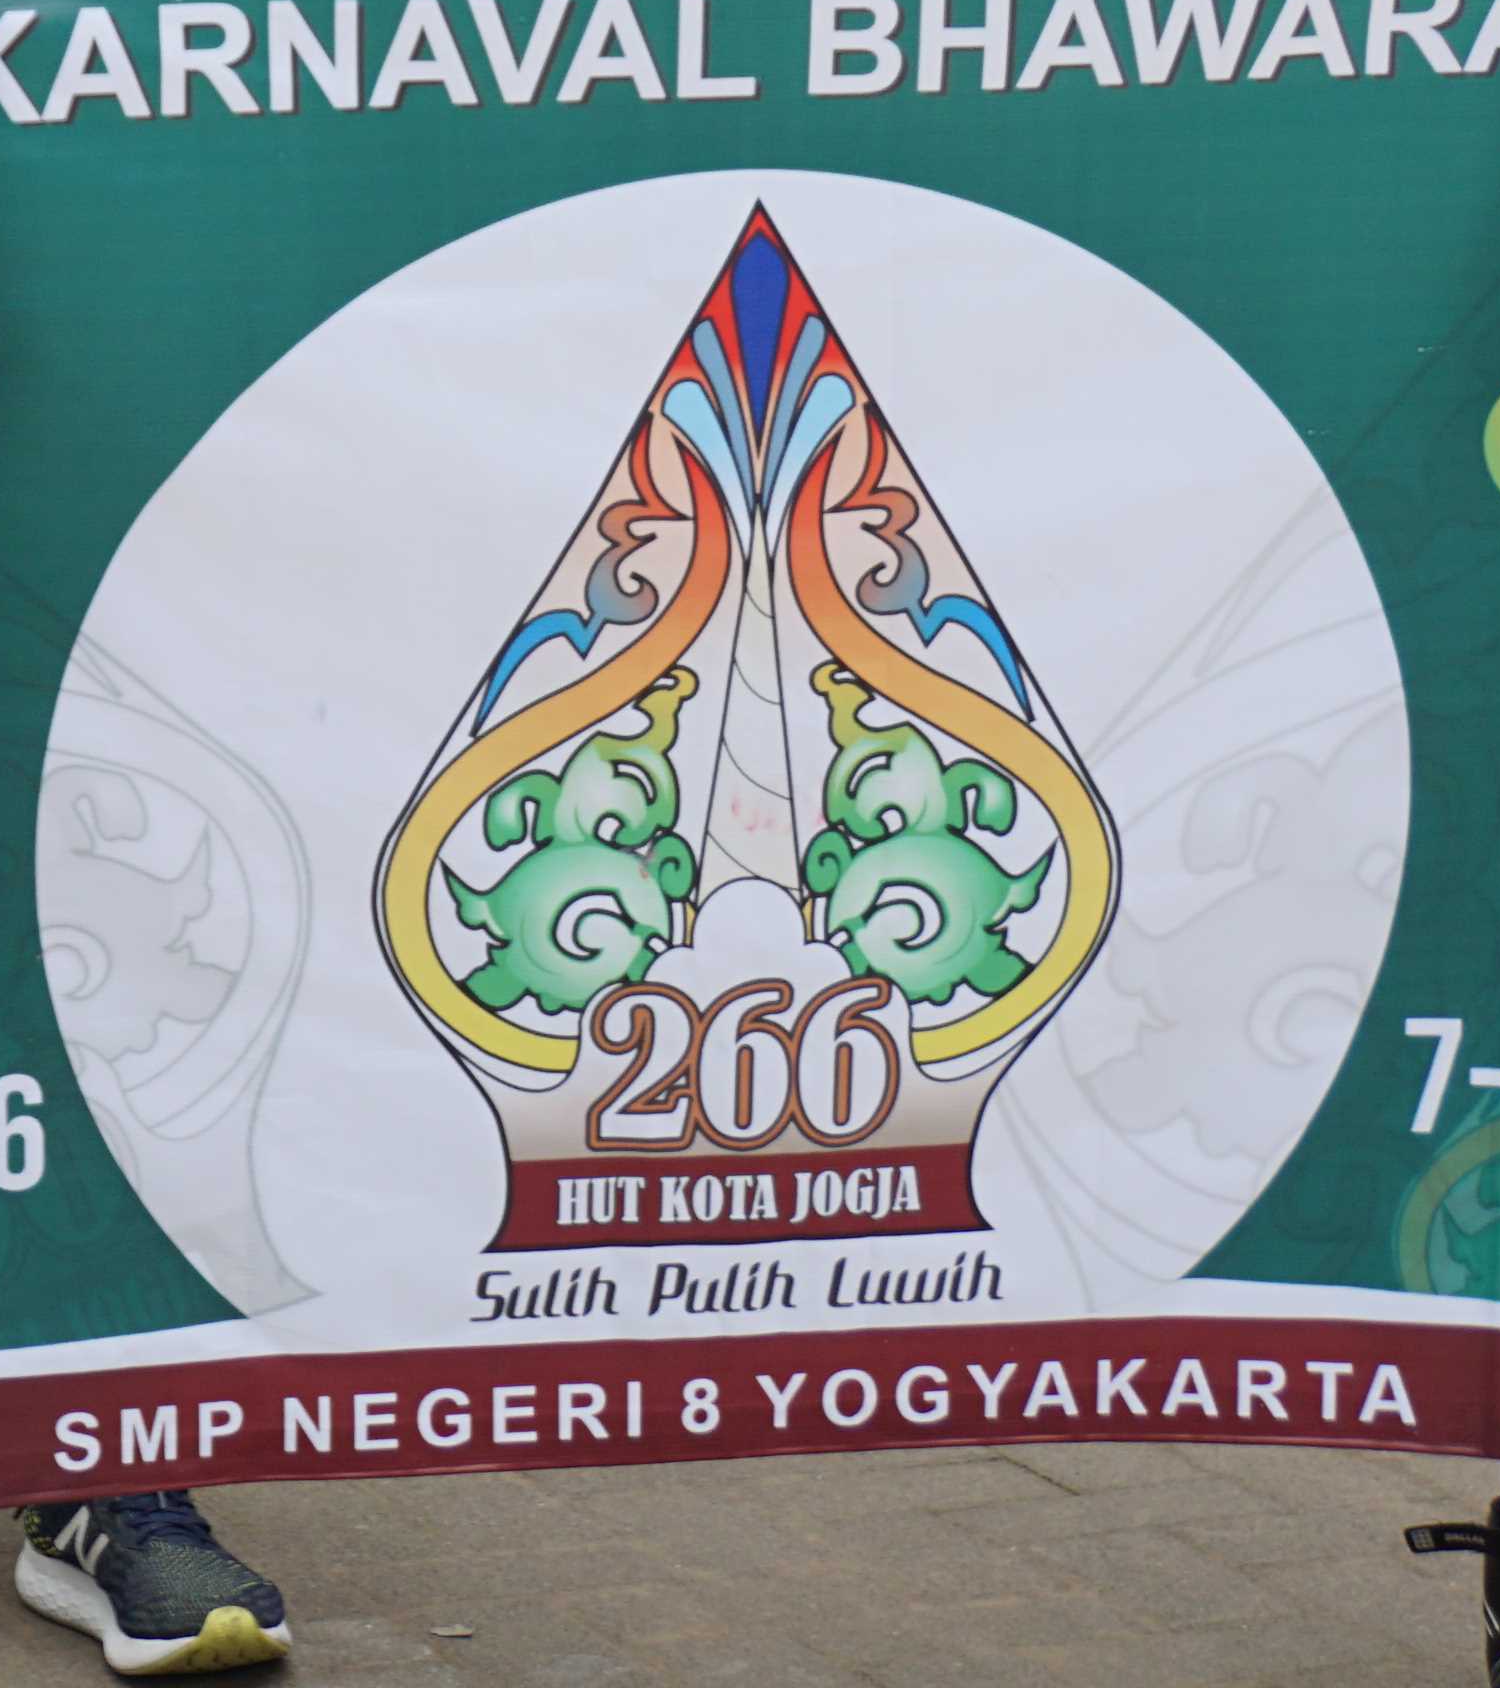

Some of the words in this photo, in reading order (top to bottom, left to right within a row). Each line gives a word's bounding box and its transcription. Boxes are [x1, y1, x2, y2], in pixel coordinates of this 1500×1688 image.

[585, 977, 900, 1152] 266
[556, 1175, 647, 1226] HUT
[658, 1173, 779, 1224] KOTA
[789, 1164, 921, 1224] JOGJA
[469, 1266, 619, 1322] Sulih
[648, 1259, 797, 1319] Pulih
[826, 1250, 1005, 1309] Luwih
[53, 1399, 245, 1473] SMP
[282, 1380, 644, 1454] NEGERI
[680, 1377, 721, 1436] 8
[755, 1358, 1418, 1428] YOGYAKARTA
